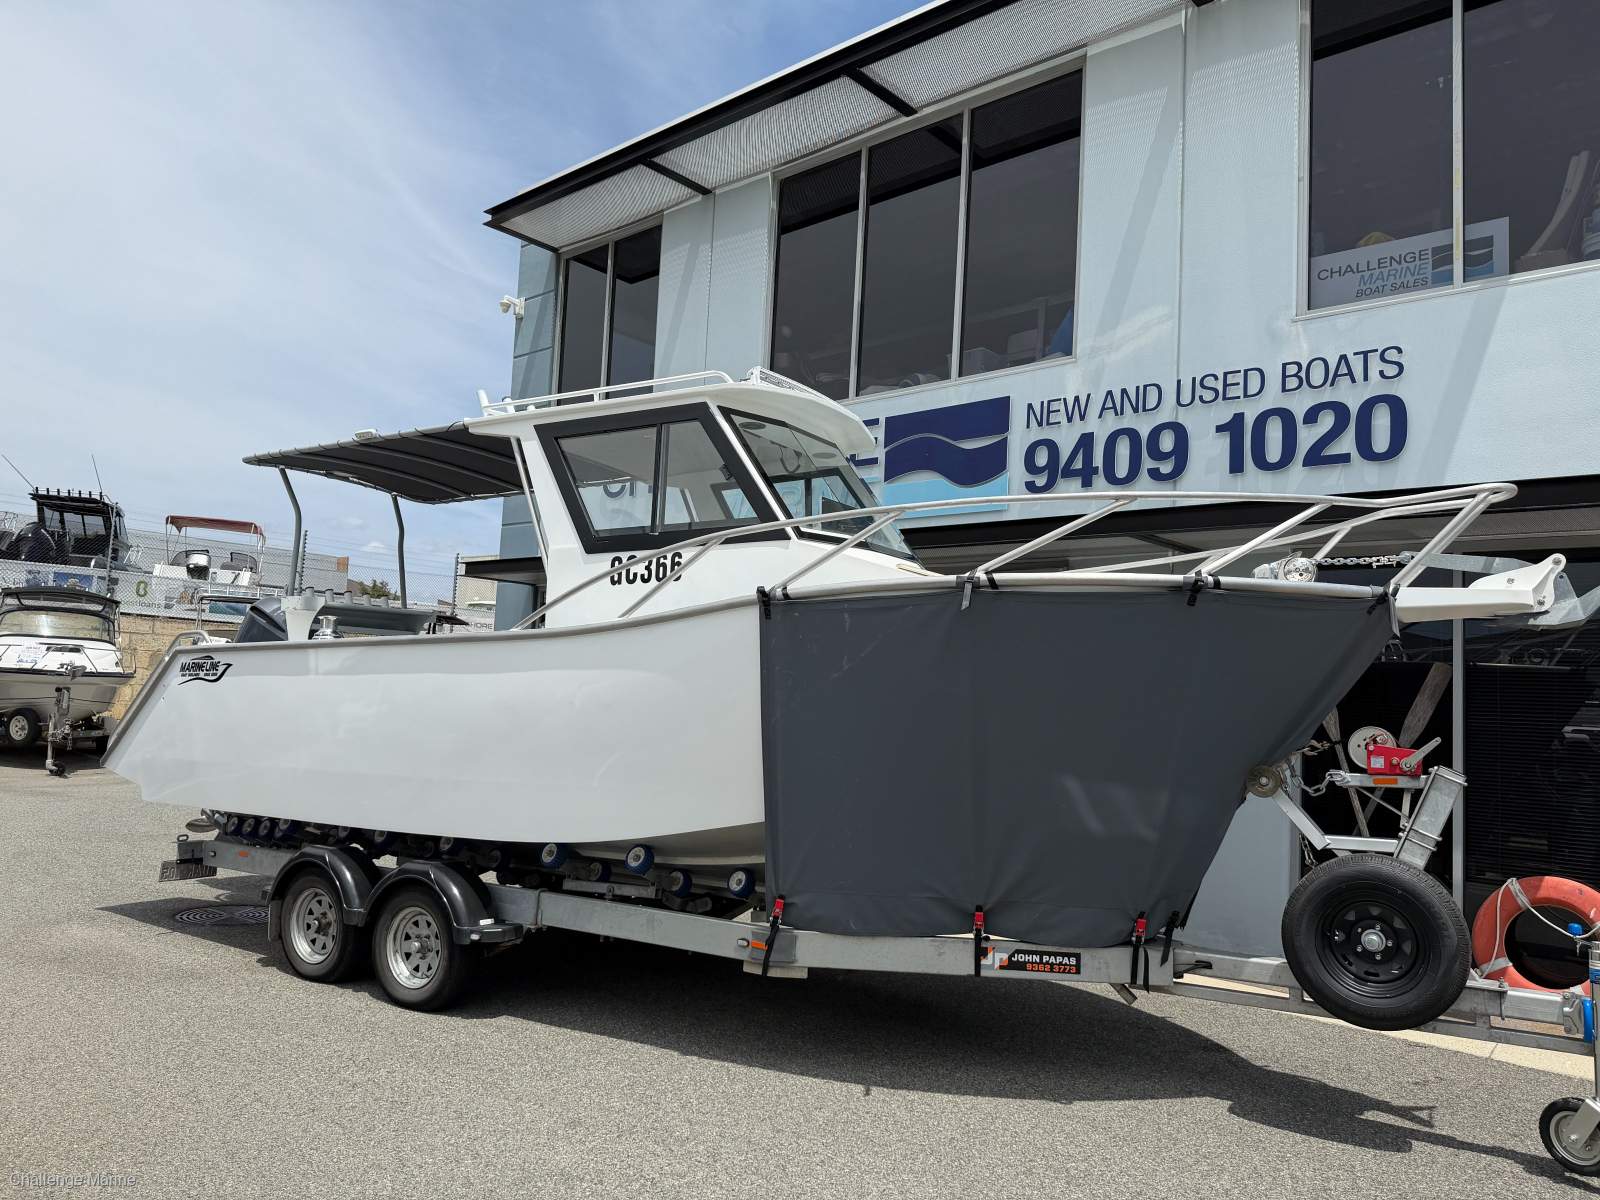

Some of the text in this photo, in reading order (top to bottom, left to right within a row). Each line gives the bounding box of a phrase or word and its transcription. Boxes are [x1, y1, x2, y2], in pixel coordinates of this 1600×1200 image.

[1317, 248, 1430, 281] CHALLENGE
[1358, 262, 1430, 288] MARINE
[1355, 276, 1429, 298] BOAT SALES
[1026, 345, 1405, 429] NEW AND USED BOATS
[1023, 393, 1409, 495] 9409 1020
[180, 661, 221, 673] MARINELINE
[1011, 953, 1077, 965] JOHN PAPAS
[1026, 963, 1077, 974] 9362 3773
